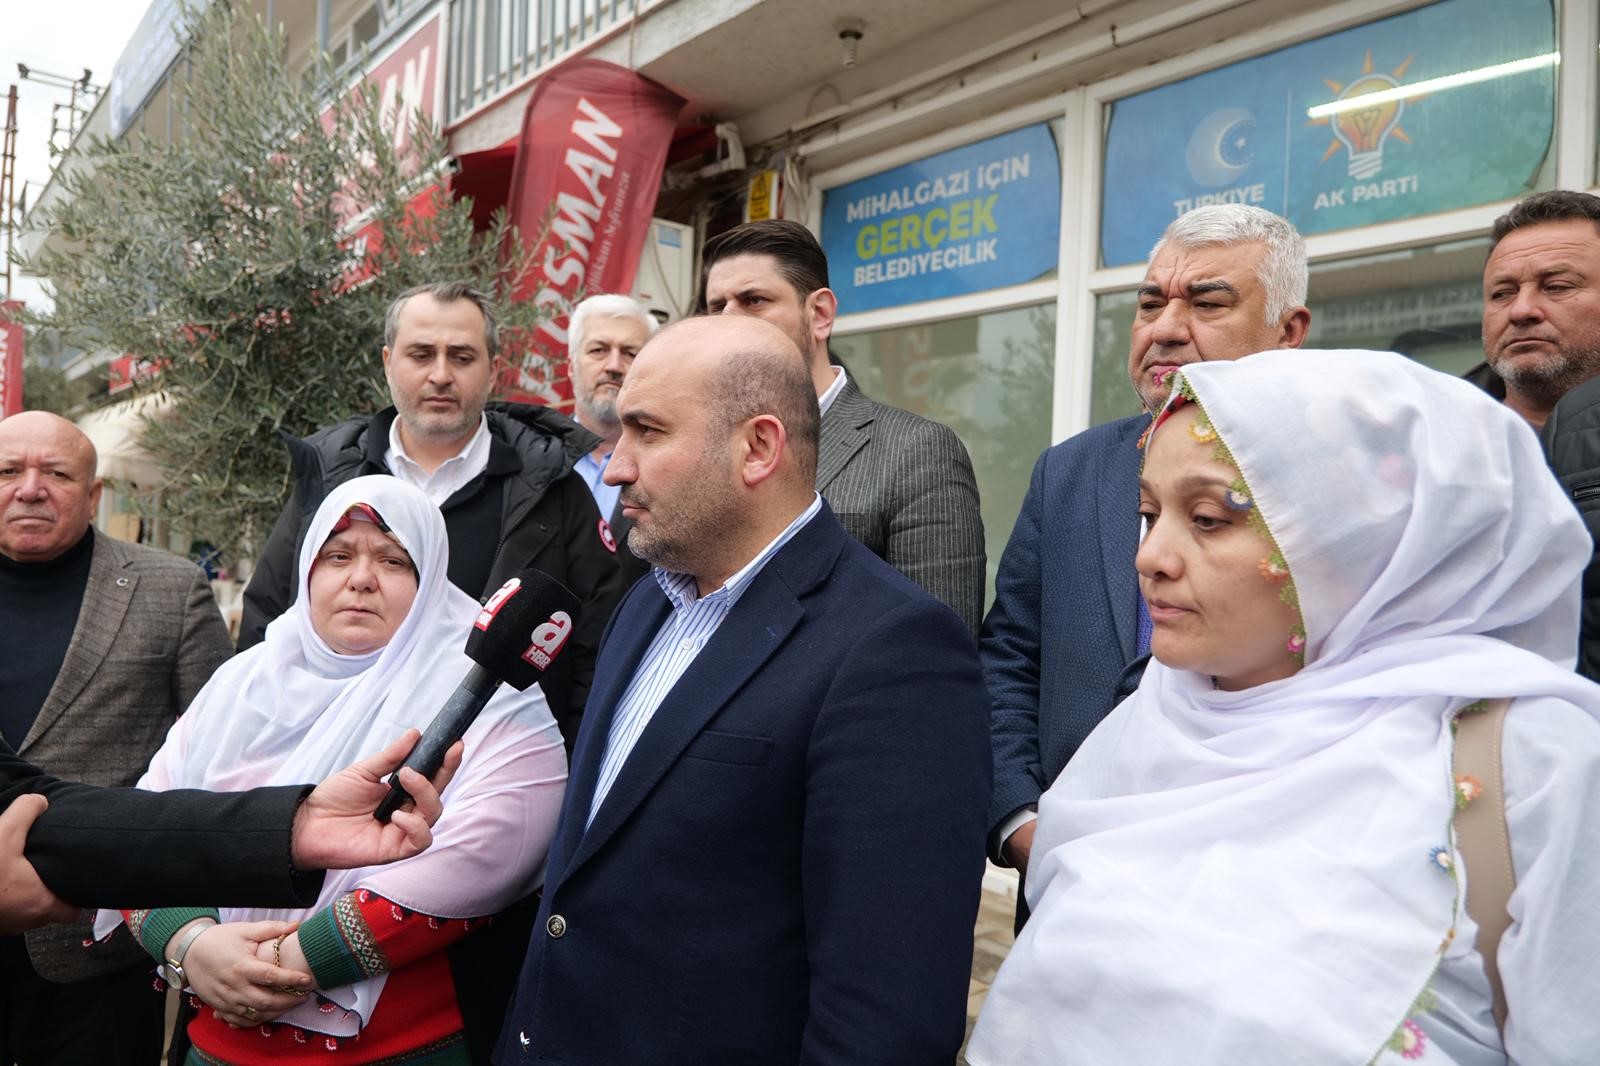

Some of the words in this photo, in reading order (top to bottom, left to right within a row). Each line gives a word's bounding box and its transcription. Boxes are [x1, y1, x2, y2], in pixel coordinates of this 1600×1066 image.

[846, 170, 969, 222] MİHALGAZİ
[977, 153, 1030, 190] İÇİN
[1313, 188, 1345, 211] AK
[1352, 175, 1418, 203] PARTİ
[856, 193, 998, 260] GERÇEK
[531, 611, 572, 656] a
